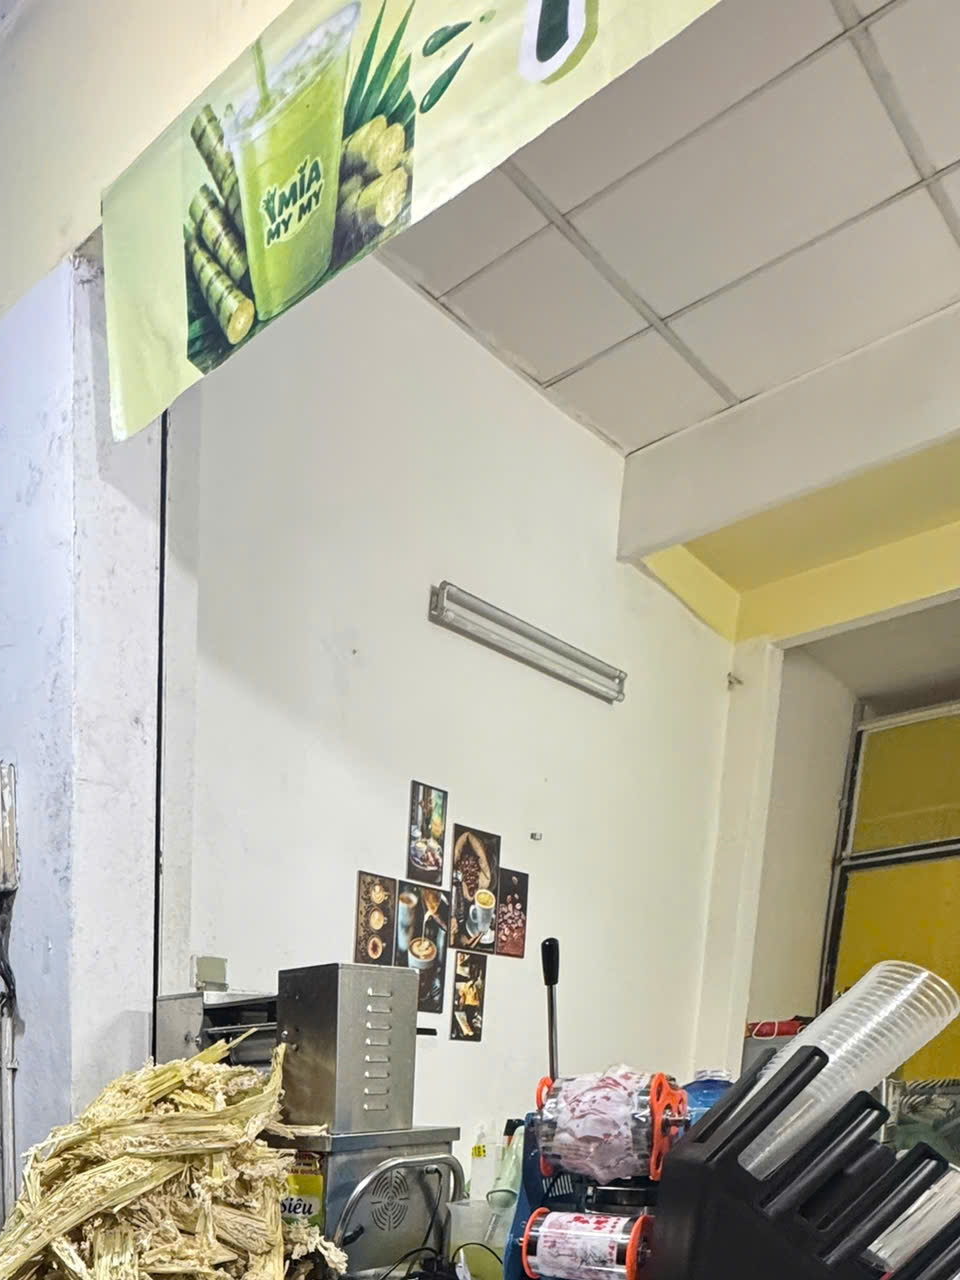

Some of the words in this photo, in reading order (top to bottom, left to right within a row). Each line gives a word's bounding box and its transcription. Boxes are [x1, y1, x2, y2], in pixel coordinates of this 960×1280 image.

[267, 212, 292, 246] MY
[297, 182, 323, 223] MY
[281, 1197, 313, 1215] Siêu
